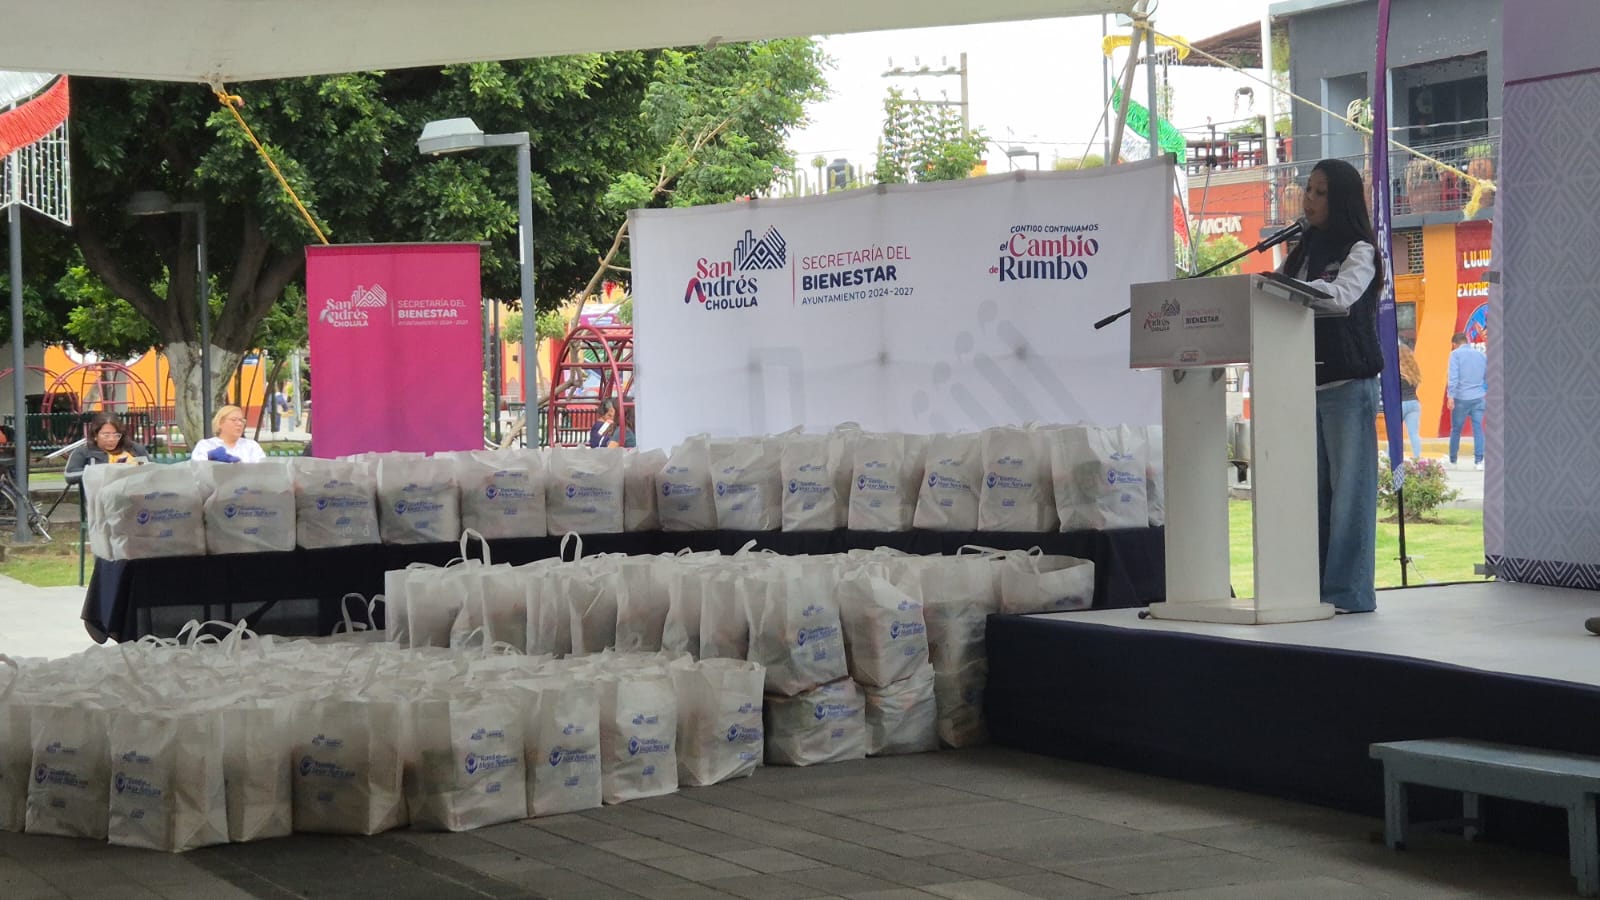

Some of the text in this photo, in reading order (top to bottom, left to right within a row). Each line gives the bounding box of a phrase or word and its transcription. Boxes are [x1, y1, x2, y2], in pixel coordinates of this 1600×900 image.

[1010, 224, 1099, 233] CONTIGO CONTINUAMOS
[1000, 233, 1099, 257] el Cambio
[802, 243, 911, 270] SECRETARÍA DEL
[696, 257, 732, 279] San
[989, 254, 1088, 281] de Rumbo
[802, 265, 897, 291] BIENESTAR
[684, 274, 758, 304] Andrés
[801, 287, 914, 306] AYUNTAMIENTO 2024-2027
[326, 298, 352, 310] San
[449, 299, 466, 307] DEL
[705, 296, 758, 311] CHOLULA
[319, 308, 369, 323] Andrés
[398, 309, 458, 319] BIENESTAR
